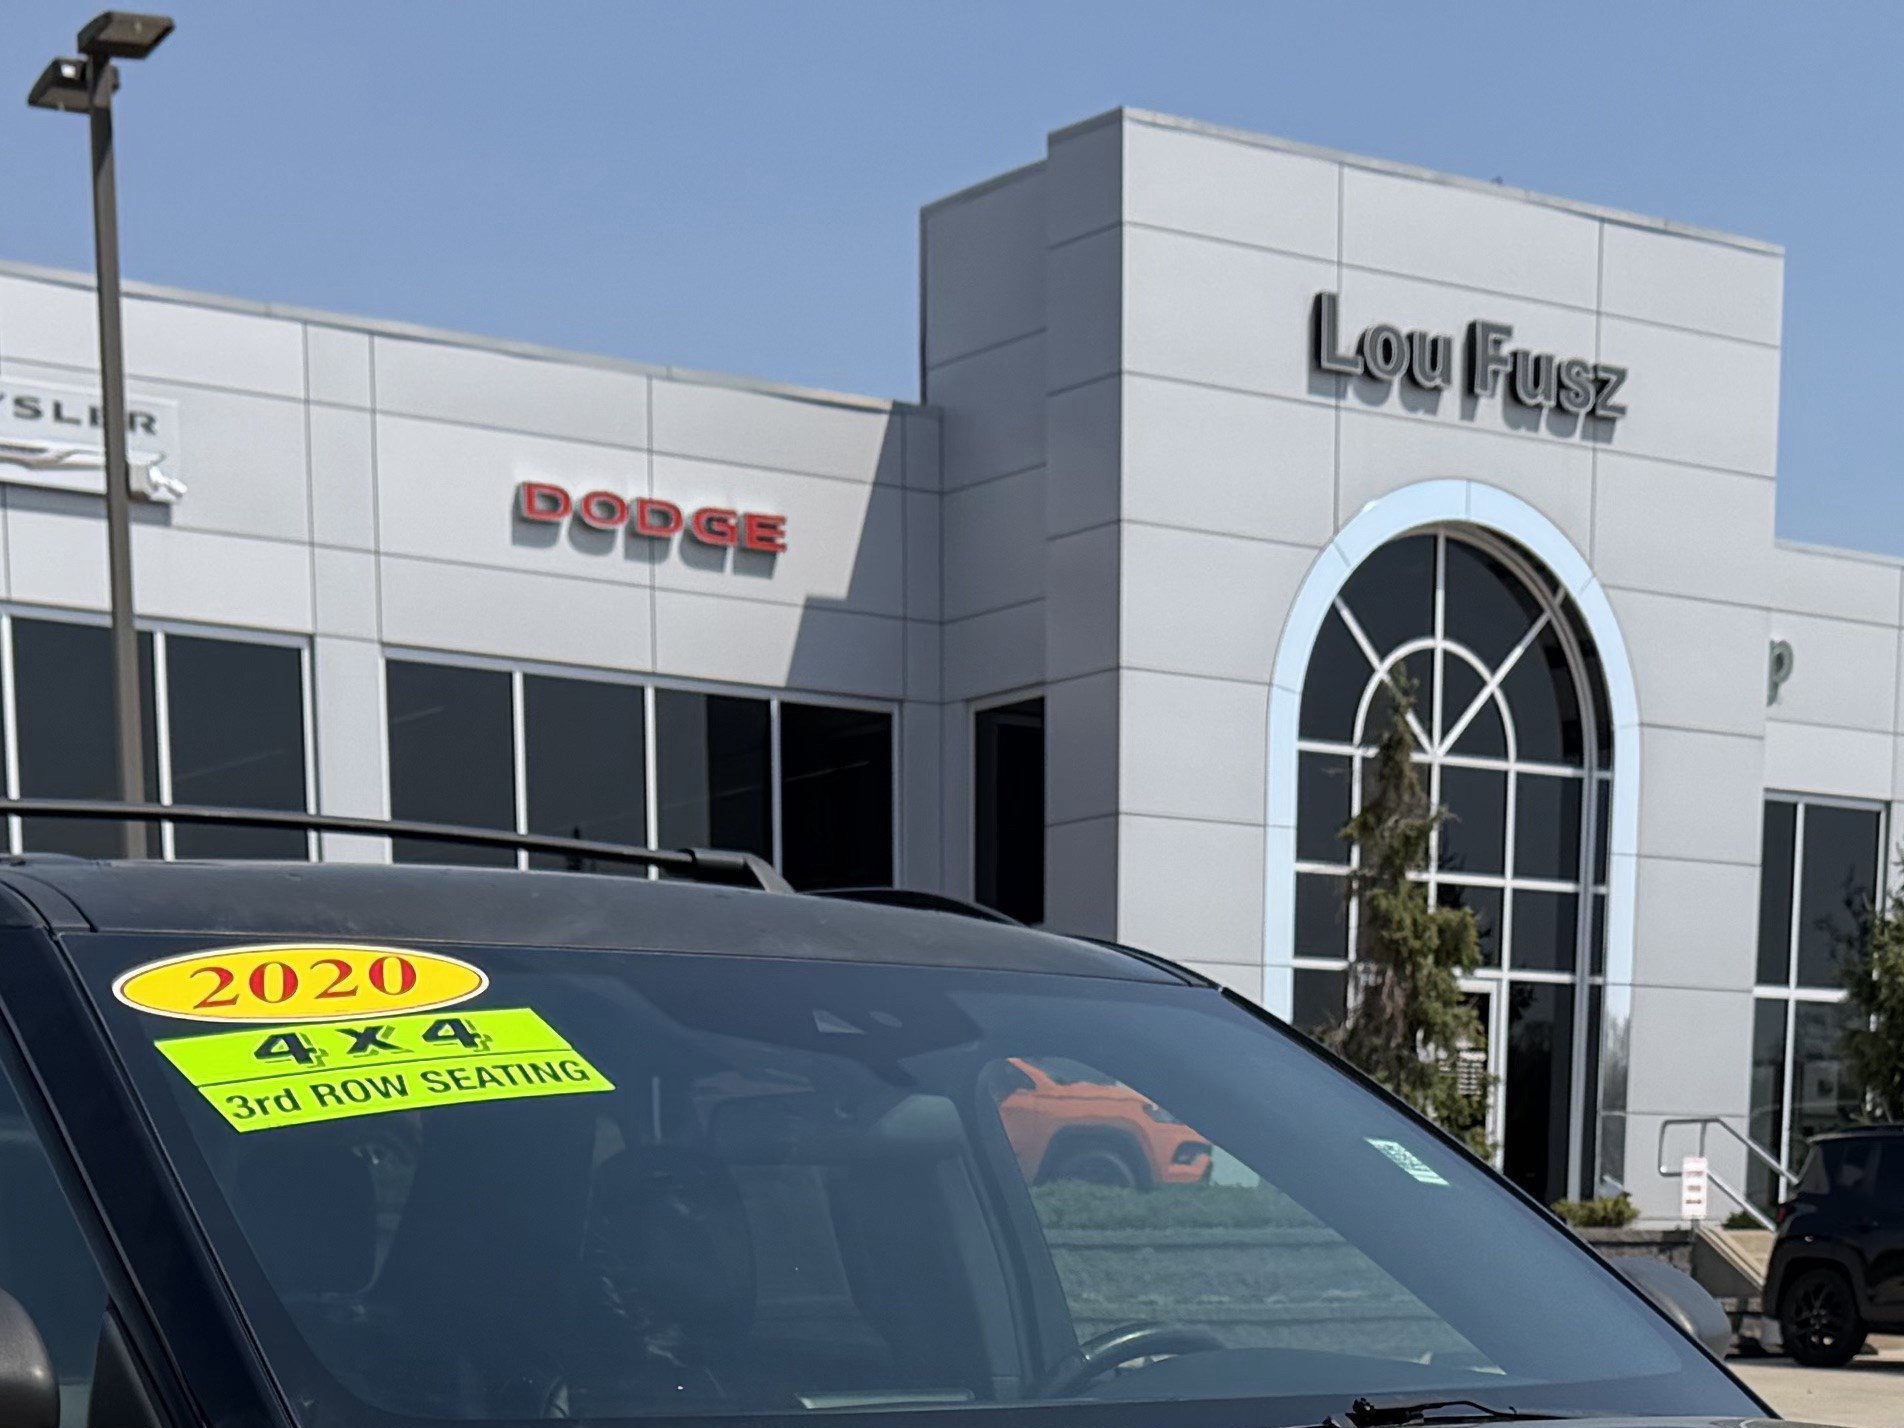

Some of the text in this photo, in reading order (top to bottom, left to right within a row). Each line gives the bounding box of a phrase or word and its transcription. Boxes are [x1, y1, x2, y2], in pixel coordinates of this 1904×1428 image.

[1309, 291, 1629, 418] Lou Fusz
[514, 480, 788, 553] DODGE
[189, 955, 417, 1010] 2020
[225, 1059, 591, 1121] 3rd ROW SEATING
